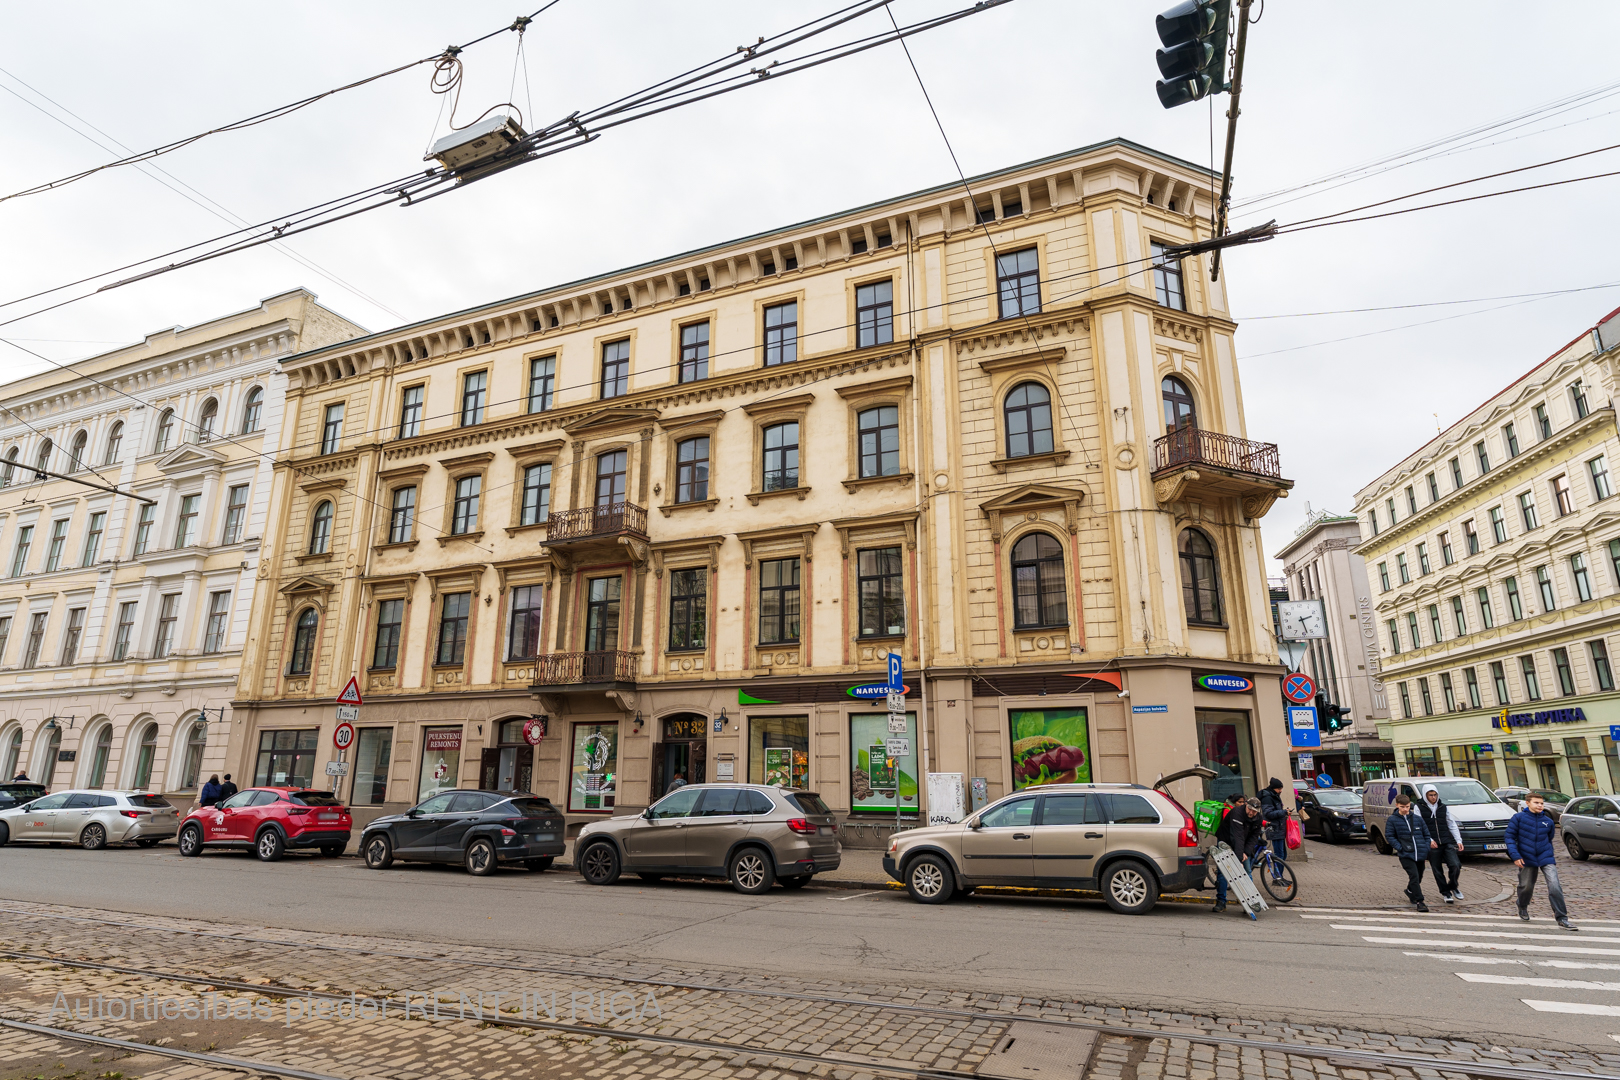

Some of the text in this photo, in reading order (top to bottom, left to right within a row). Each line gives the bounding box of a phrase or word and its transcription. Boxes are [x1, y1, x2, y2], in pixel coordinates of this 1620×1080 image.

[1360, 595, 1374, 638] CENTRS
[892, 658, 899, 684] P
[1207, 678, 1245, 688] NARVESEN
[1491, 707, 1587, 728] MĒNESS APTIEKA
[691, 721, 705, 734] 32
[338, 730, 350, 743] 30
